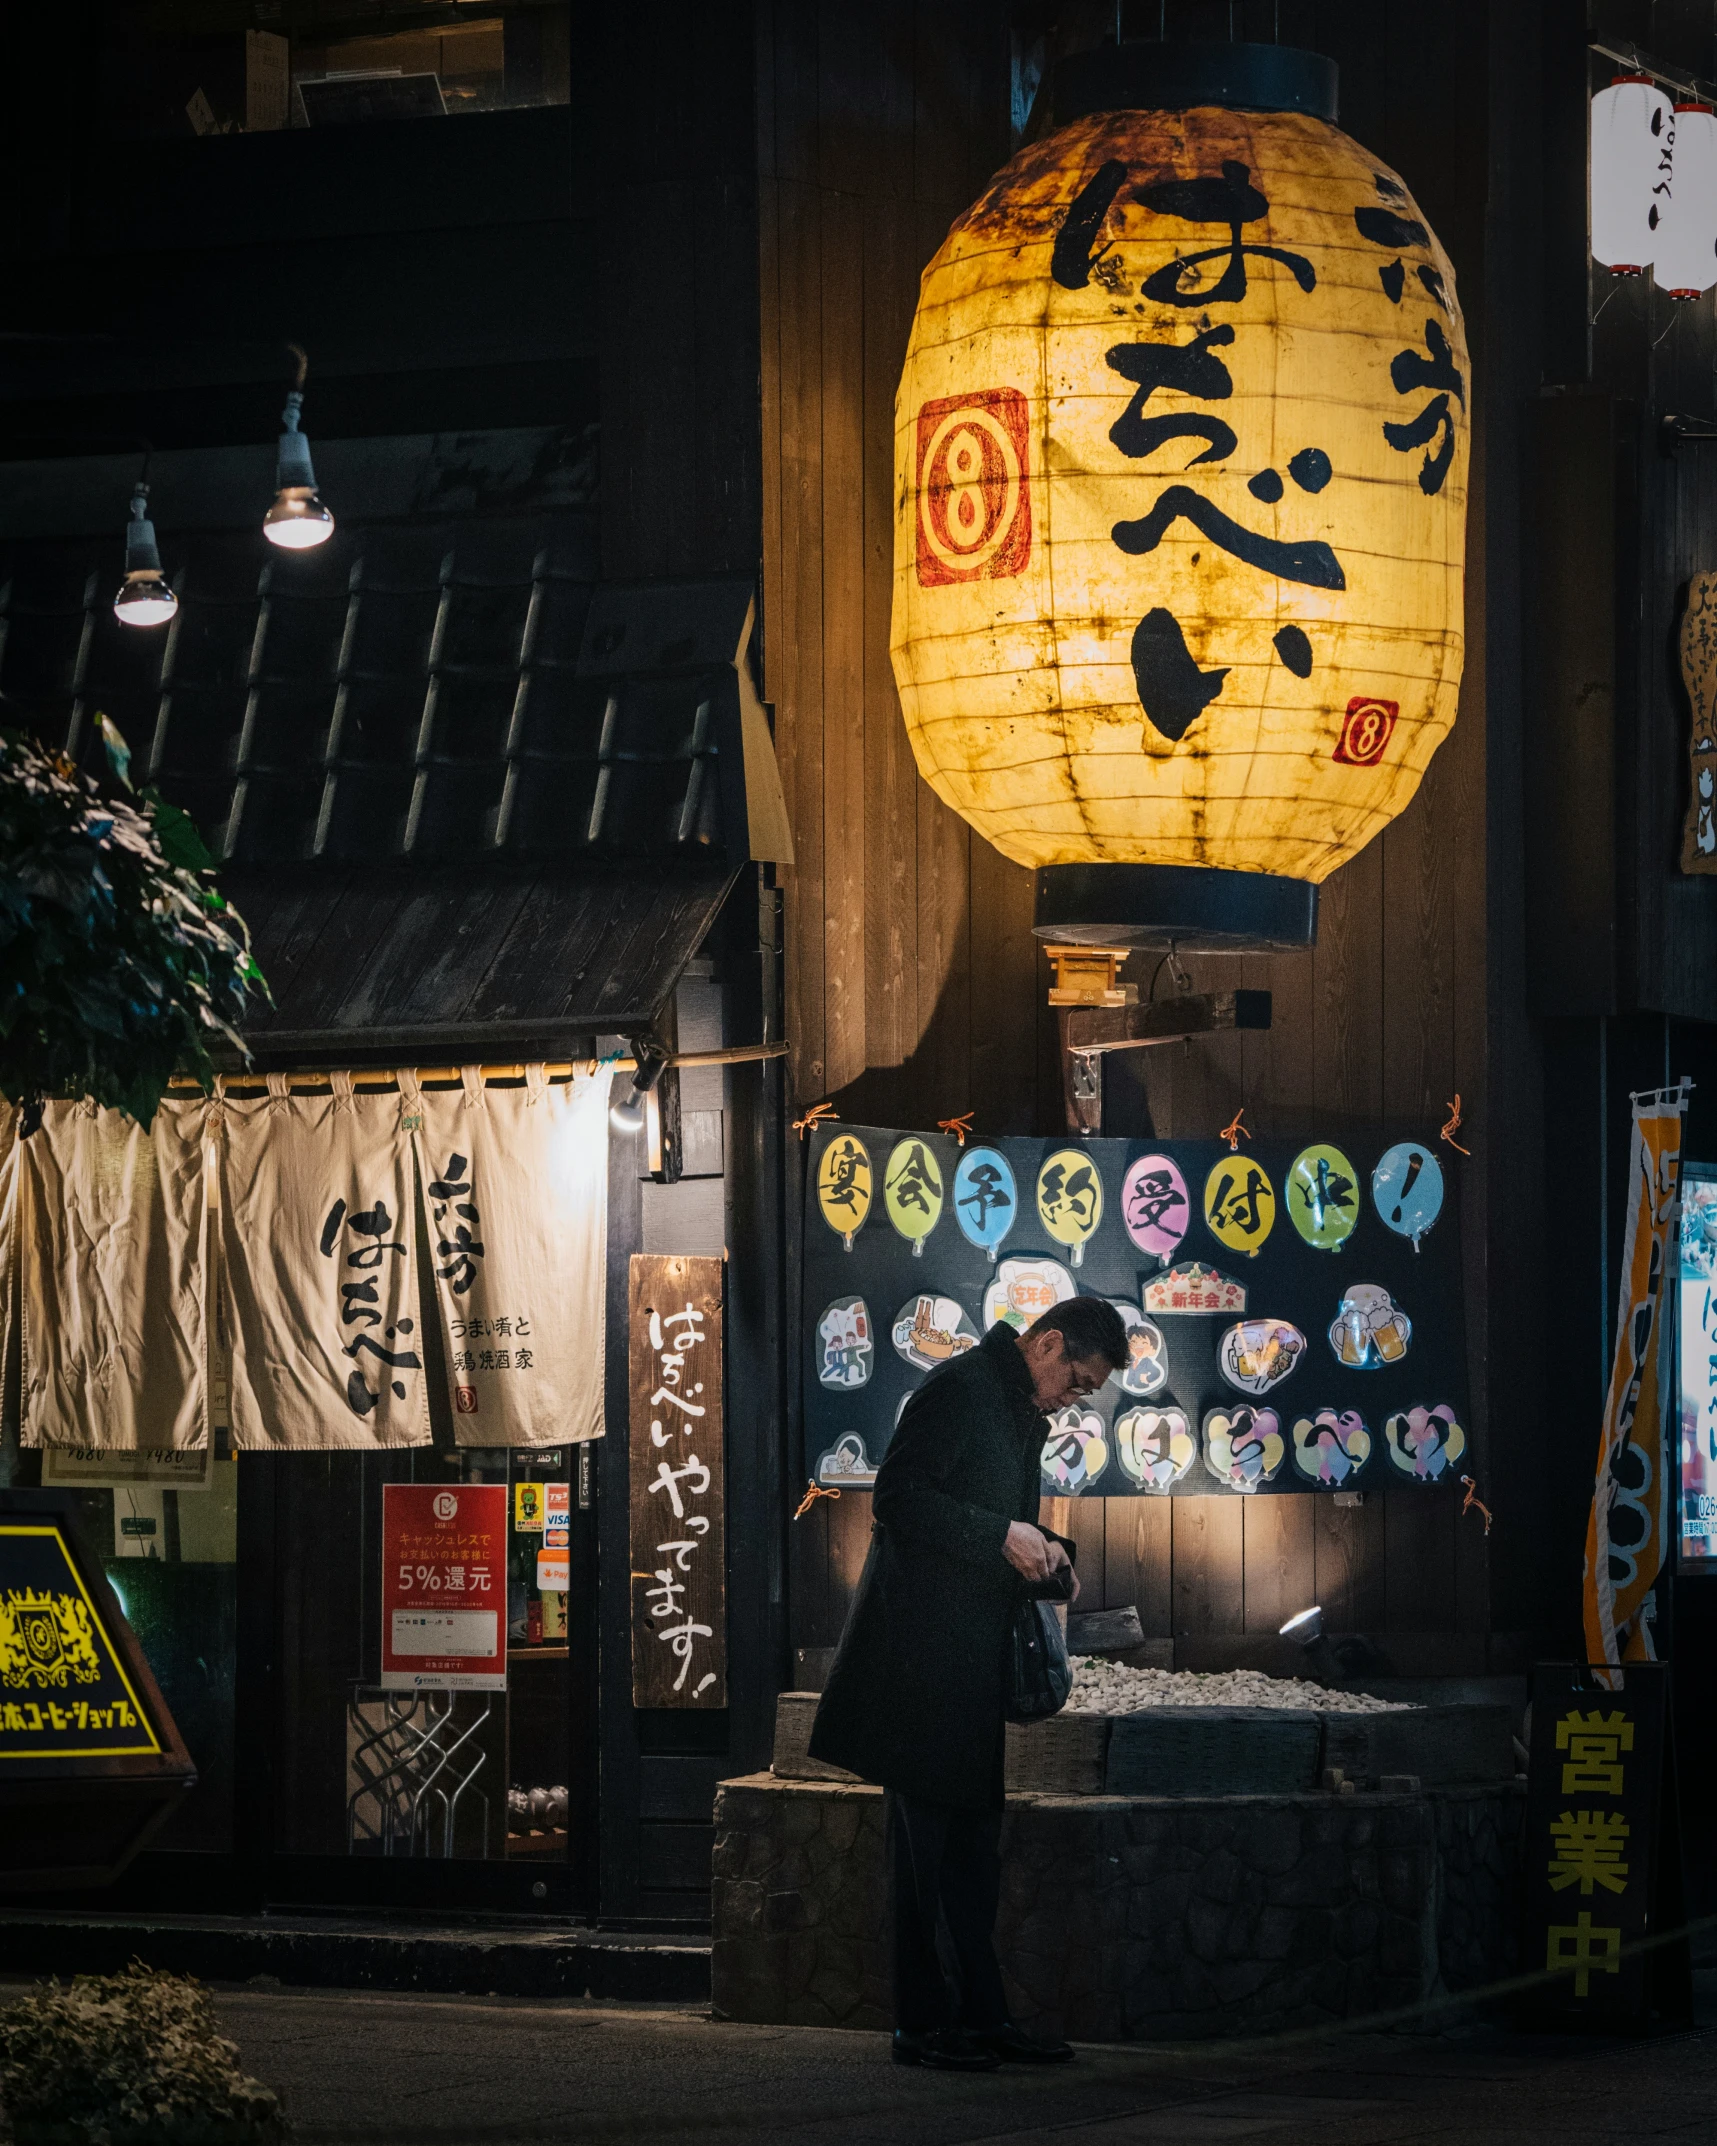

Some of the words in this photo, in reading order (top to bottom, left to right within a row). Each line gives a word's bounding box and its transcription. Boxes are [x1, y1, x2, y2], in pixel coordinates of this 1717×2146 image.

[1354, 172, 1465, 497] 六方
[1050, 160, 1346, 742] はちべい
[428, 1152, 485, 1295] 六方
[319, 1197, 423, 1416] はちべい
[1013, 1285, 1052, 1308] 忘年会
[1171, 1291, 1221, 1309] 新年会
[450, 1316, 531, 1339] うまい肴と
[547, 1514, 571, 1525] VISA
[400, 1533, 492, 1547] キャッシュレスで
[400, 1549, 492, 1561] お支払いのお客様に
[399, 1565, 492, 1591] 5%還元
[0, 1700, 137, 1731] 本コーヒーショップ
[1547, 1710, 1635, 1998] 営業中
